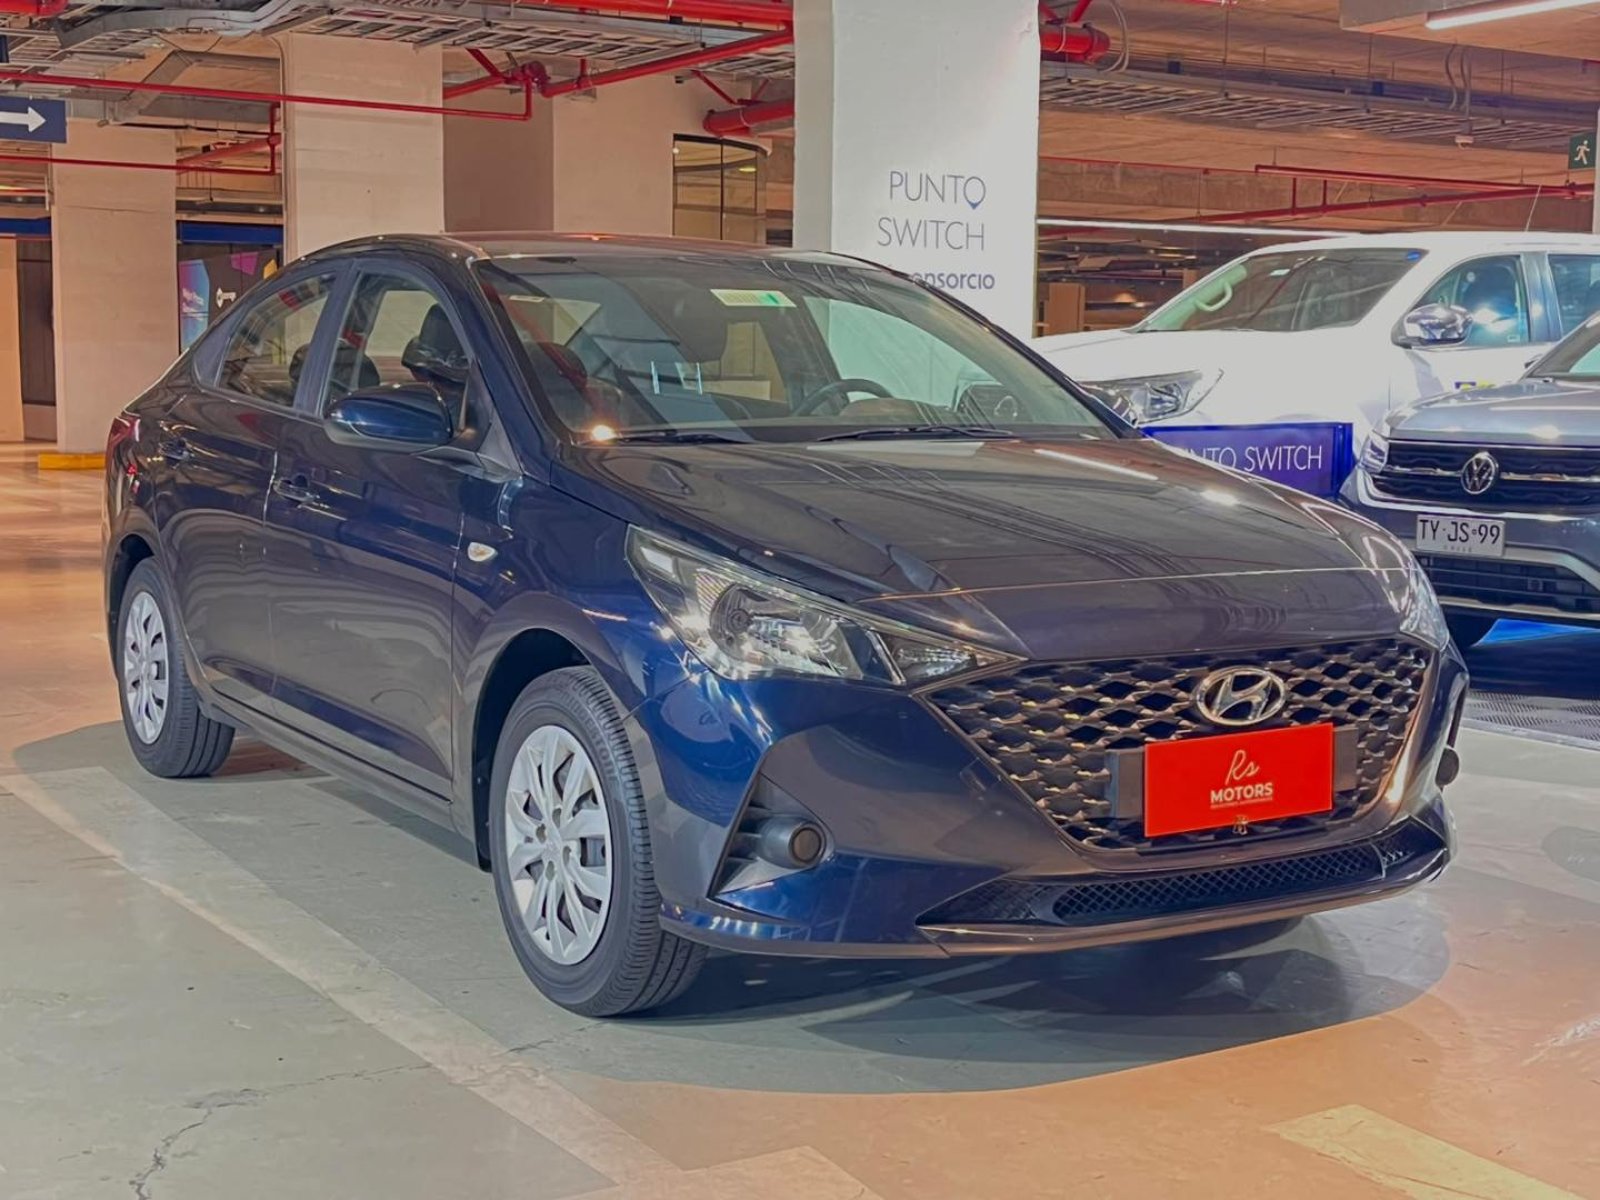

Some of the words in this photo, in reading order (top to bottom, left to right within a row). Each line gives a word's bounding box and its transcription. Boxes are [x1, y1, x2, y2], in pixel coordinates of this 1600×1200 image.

[889, 170, 986, 210] PUNTO
[877, 216, 985, 251] SWITCH
[911, 272, 996, 290] nsorcio
[1244, 445, 1323, 472] SWITCH
[1210, 781, 1274, 804] MOTORS
